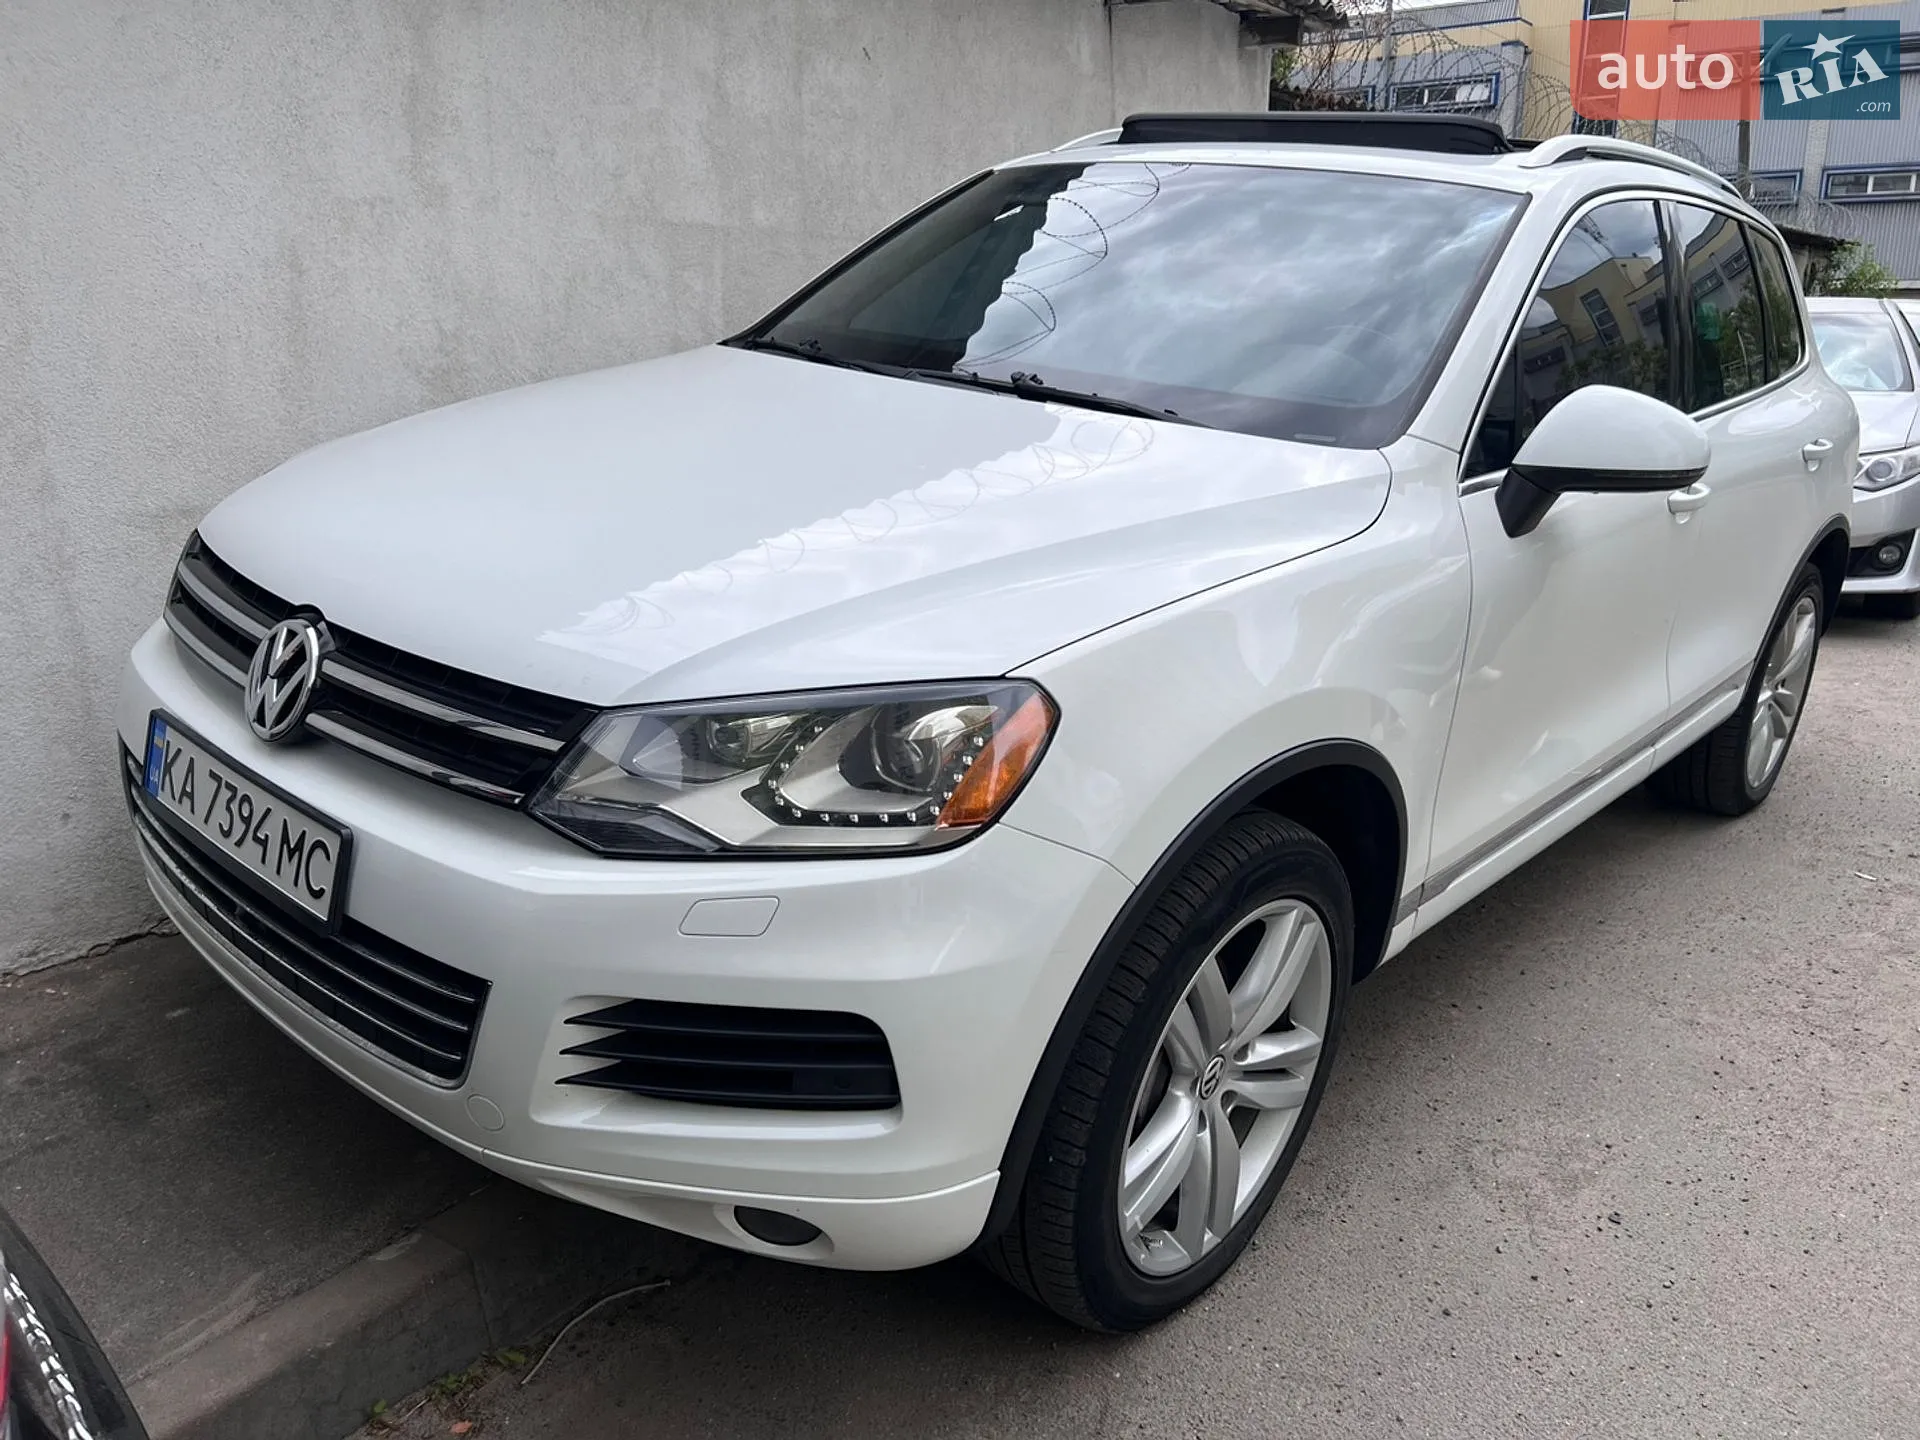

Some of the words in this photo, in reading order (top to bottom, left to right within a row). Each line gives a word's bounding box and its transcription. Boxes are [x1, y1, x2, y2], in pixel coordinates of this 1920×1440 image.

[161, 740, 195, 815] KA
[203, 768, 272, 865] 7394
[275, 818, 331, 899] MC
